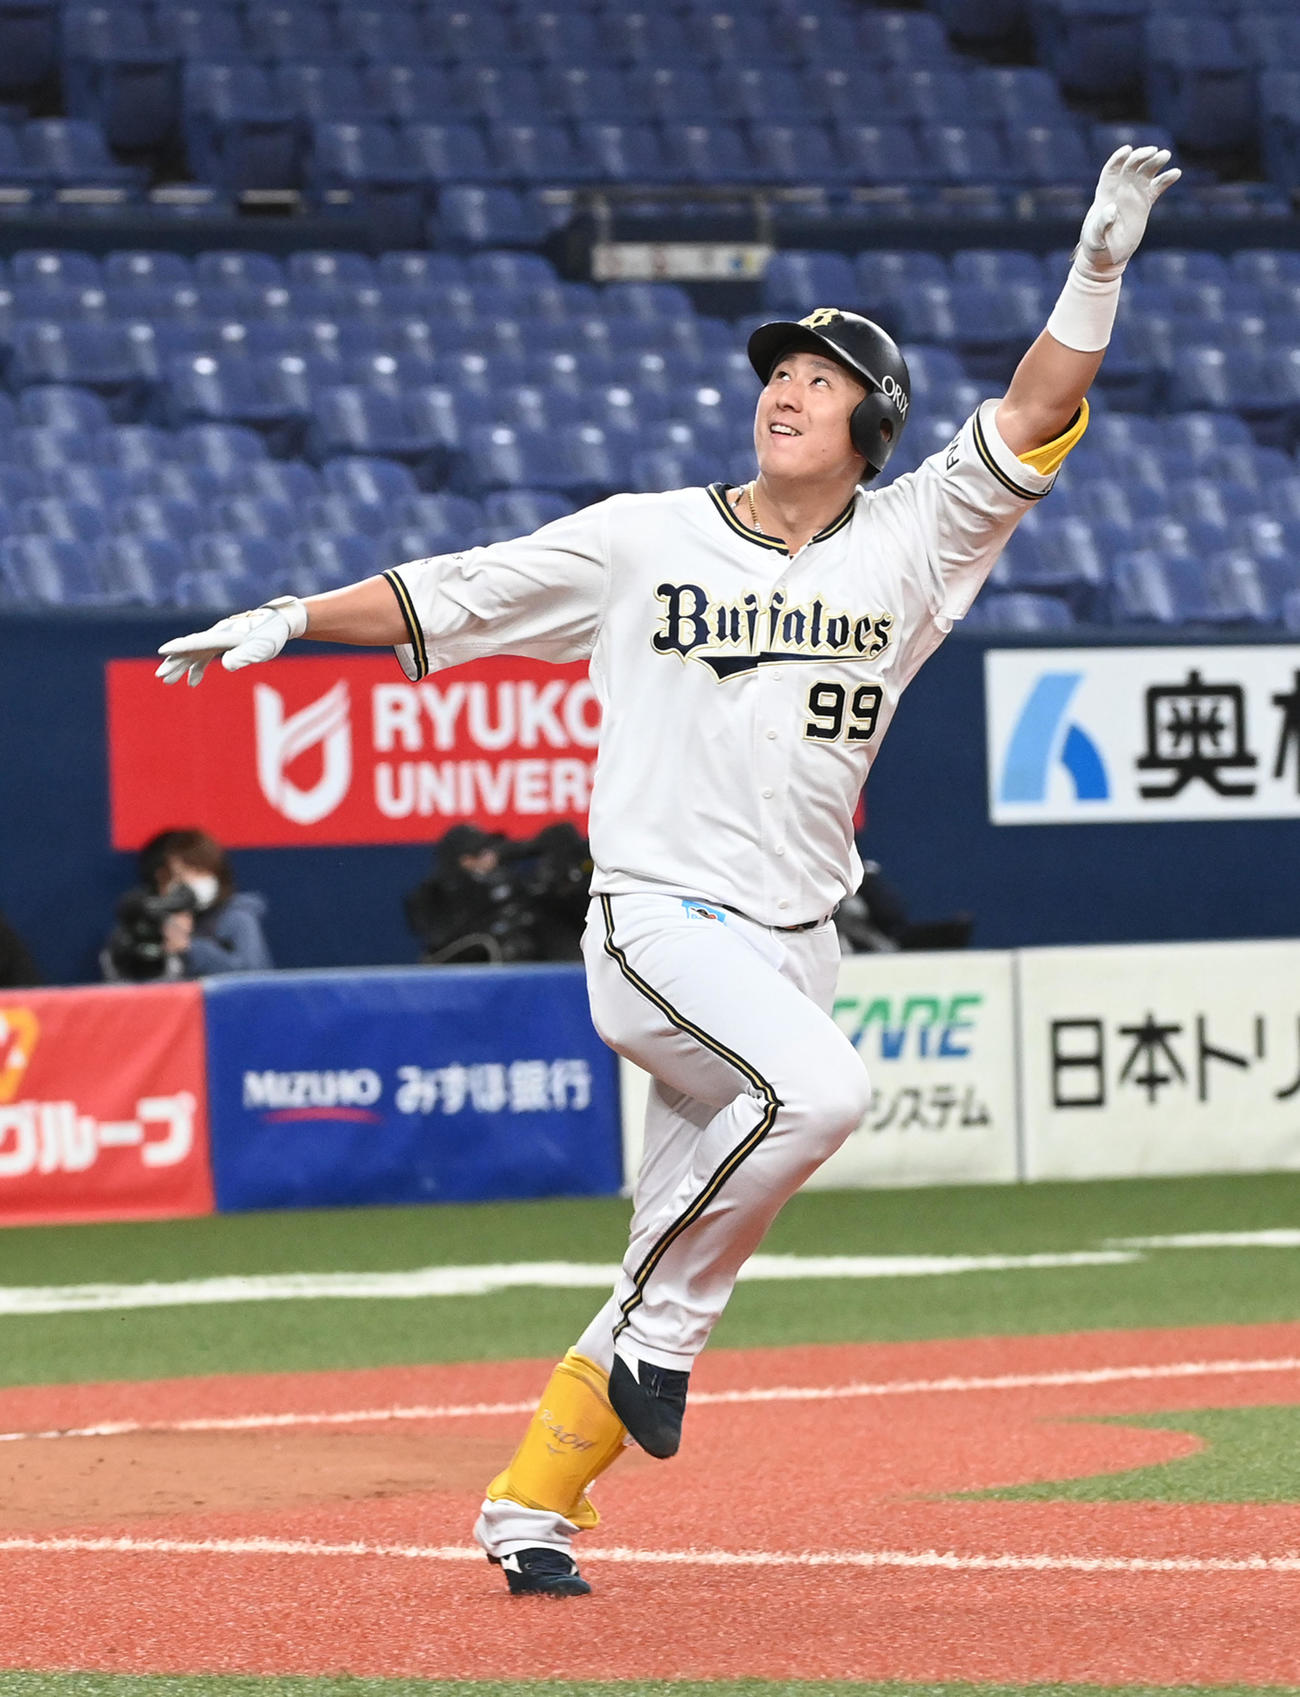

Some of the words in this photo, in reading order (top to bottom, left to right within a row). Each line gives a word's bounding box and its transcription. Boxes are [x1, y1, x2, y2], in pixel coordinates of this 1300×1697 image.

[882, 375, 909, 420] ORIX
[651, 582, 893, 664] Buffaloes
[803, 679, 884, 742] 99
[243, 1068, 382, 1110] MIZUHO
